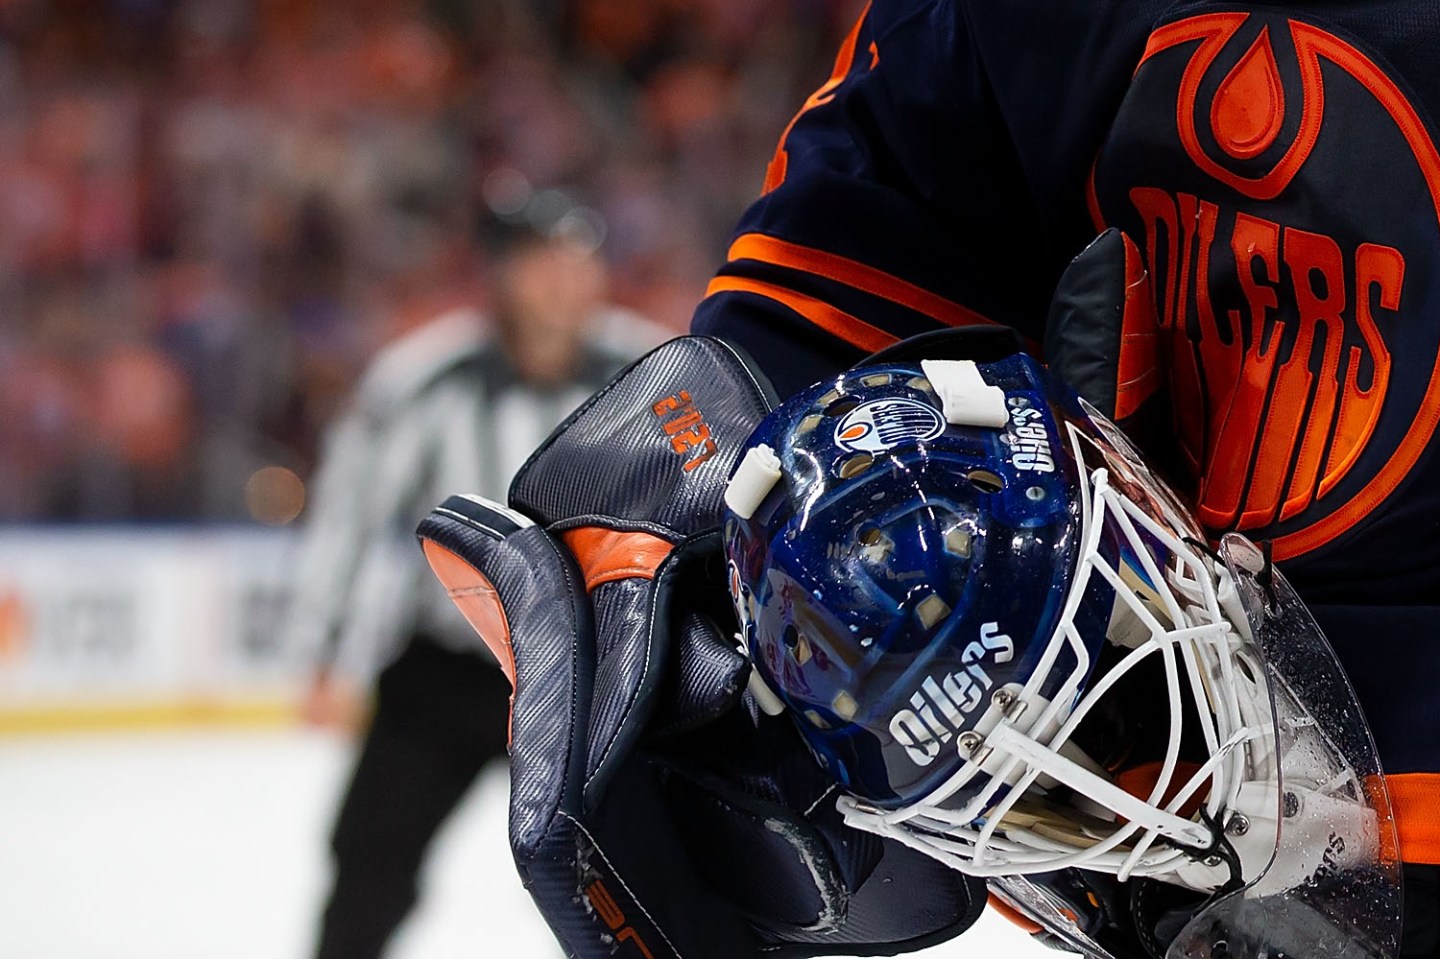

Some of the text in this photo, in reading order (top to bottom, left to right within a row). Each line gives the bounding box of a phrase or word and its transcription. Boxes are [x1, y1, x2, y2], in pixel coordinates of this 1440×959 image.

[1129, 186, 1405, 530] OILERS
[869, 403, 936, 445] OILERS
[1009, 407, 1055, 472] Oilers
[889, 621, 1014, 767] Oilers
